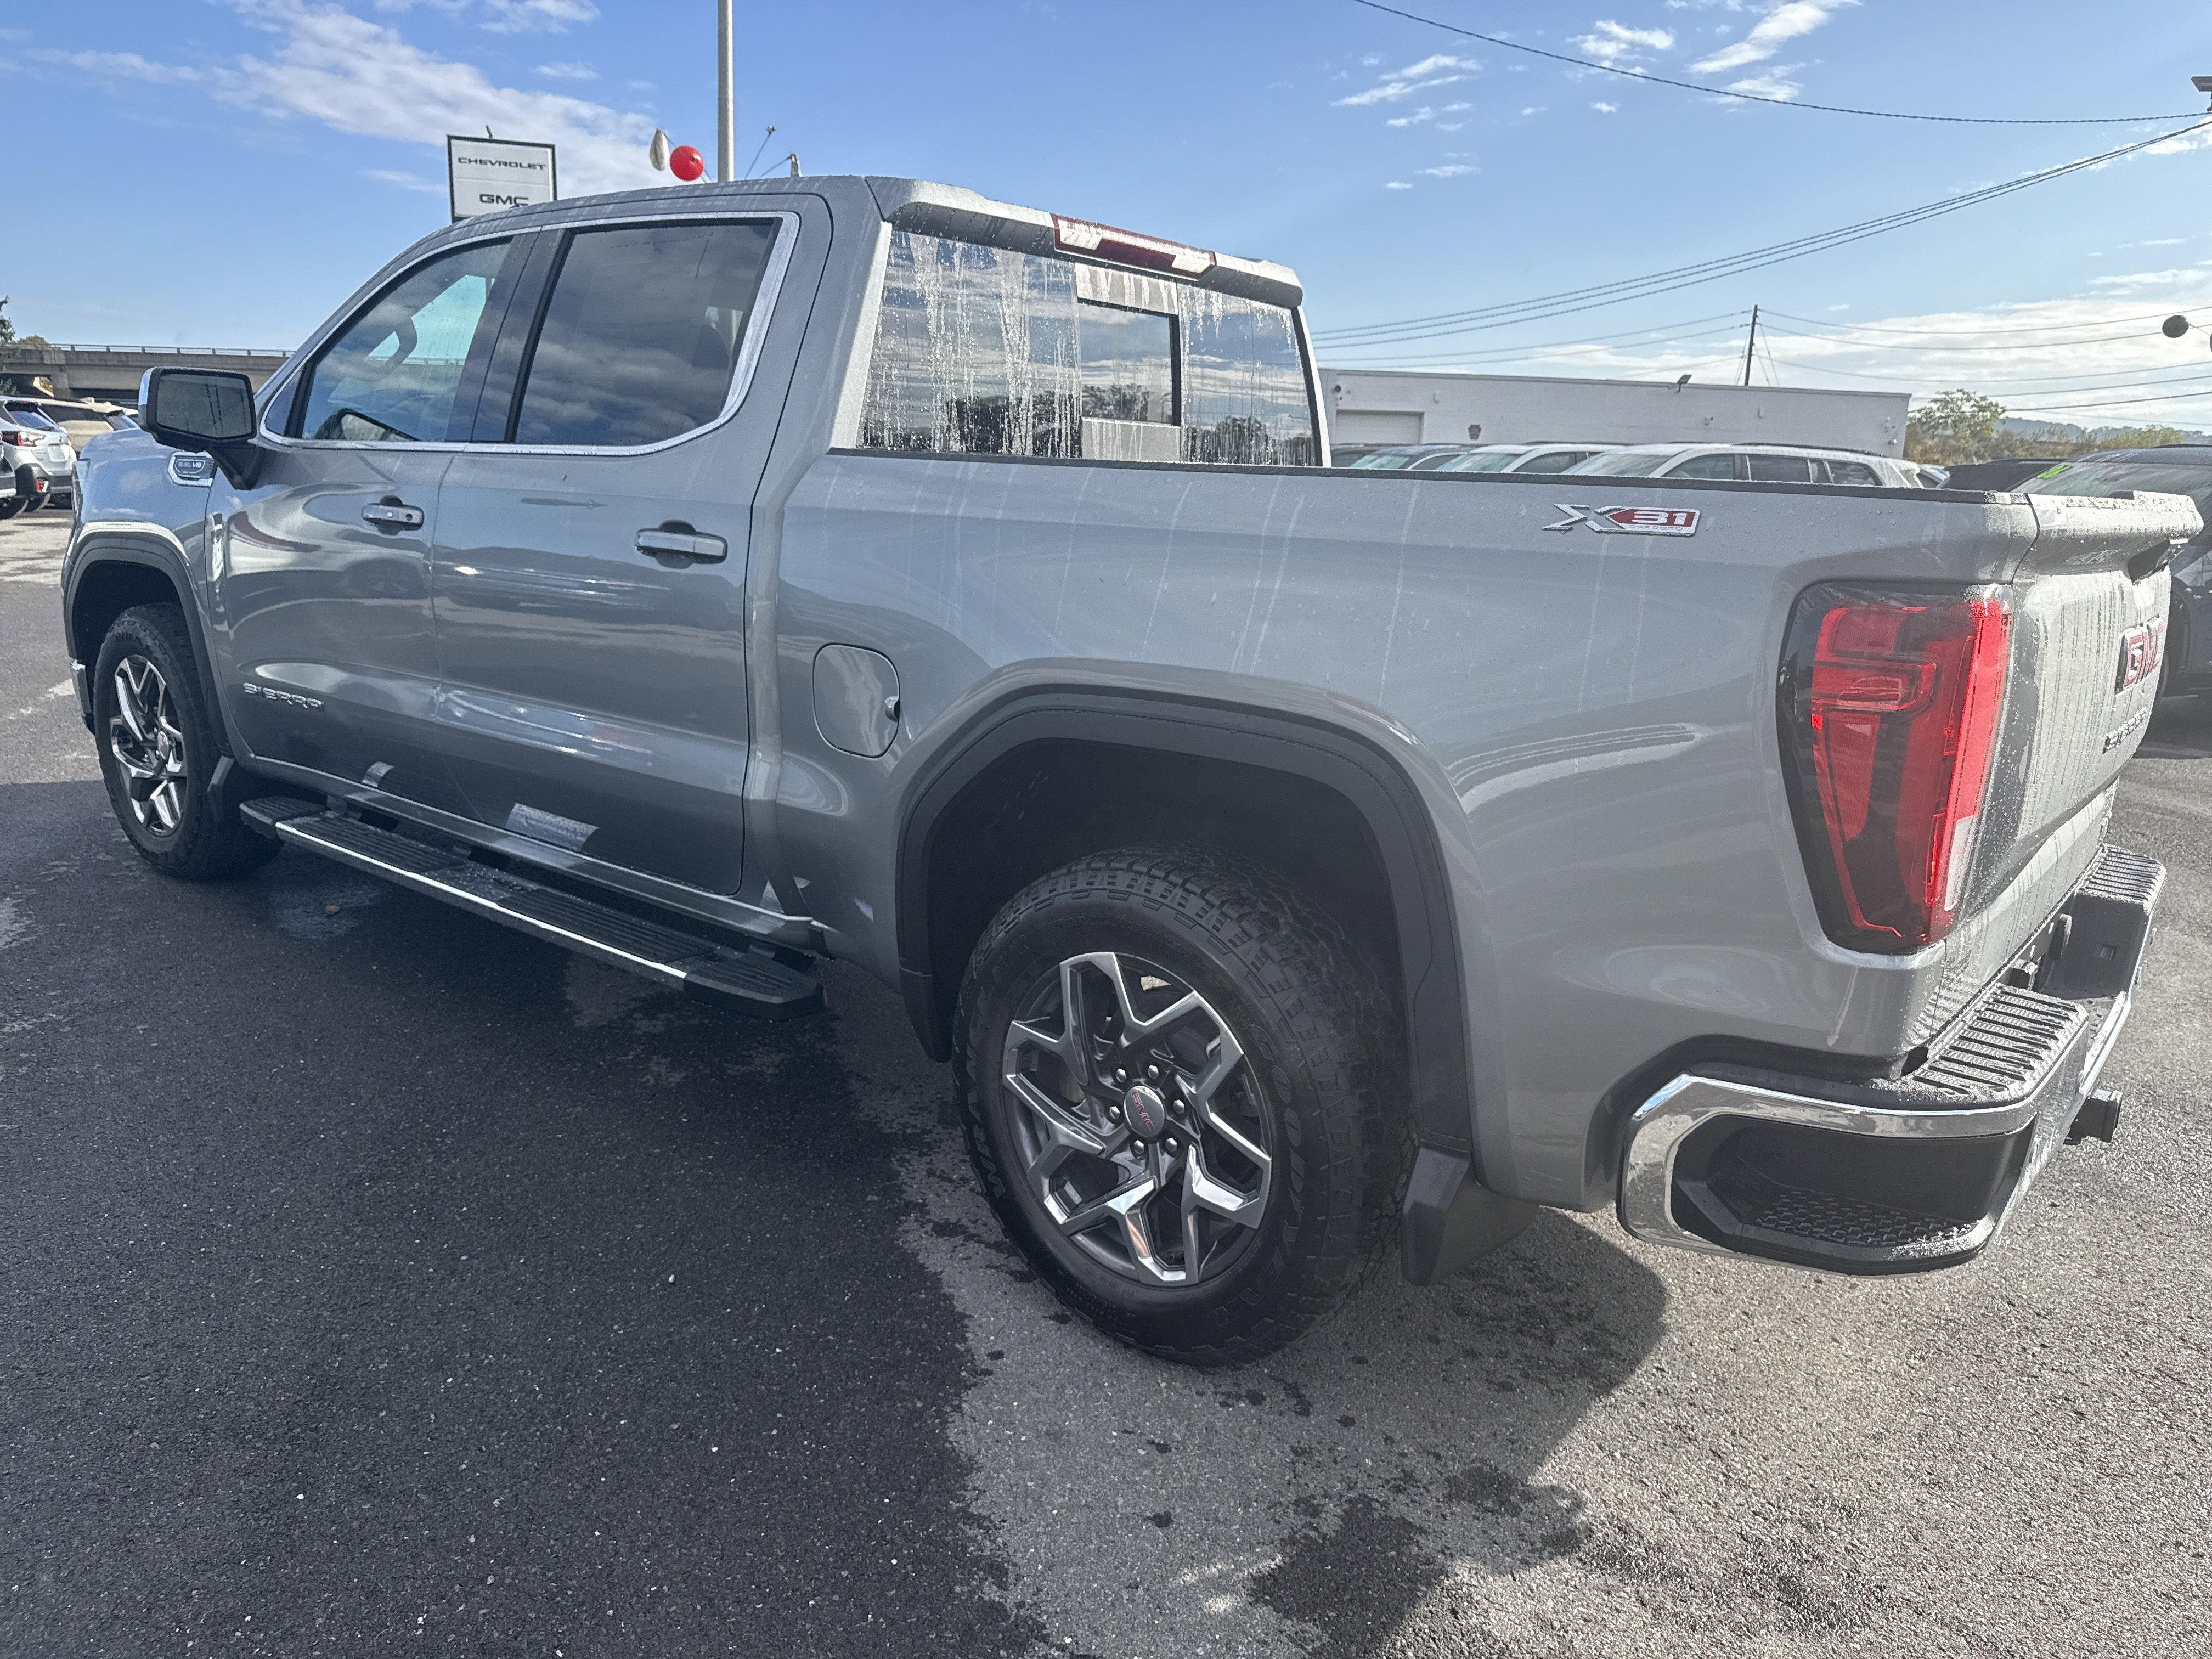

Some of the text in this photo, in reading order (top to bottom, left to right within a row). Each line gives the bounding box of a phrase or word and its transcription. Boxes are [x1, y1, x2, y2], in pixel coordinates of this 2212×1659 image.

[458, 157, 545, 170] CHEVROLET
[479, 194, 529, 206] GMC
[243, 682, 324, 712] SIERRA
[1131, 1091, 1155, 1132] GMC
